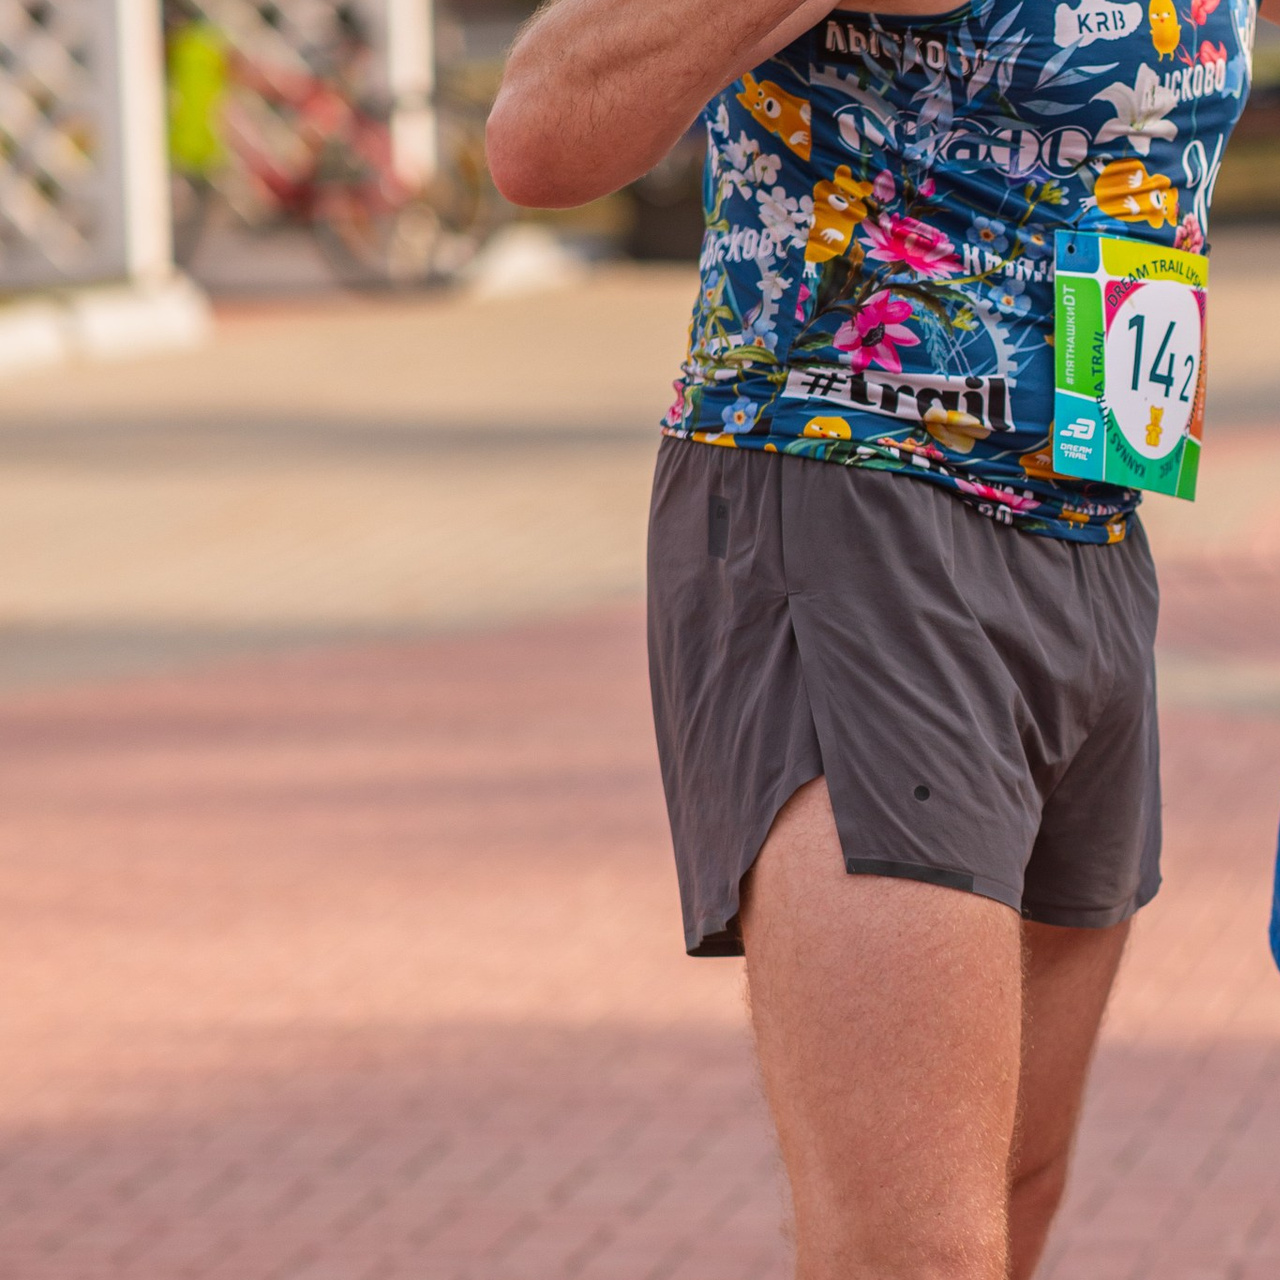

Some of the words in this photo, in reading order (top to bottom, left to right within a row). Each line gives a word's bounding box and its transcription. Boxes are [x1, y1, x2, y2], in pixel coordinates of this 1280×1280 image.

[1077, 9, 1126, 35] KRB
[1107, 263, 1150, 308] DREAM
[1151, 258, 1184, 276] TRAIL
[1090, 329, 1106, 378] TRAIL
[1059, 442, 1093, 456] DREAM
[1063, 450, 1089, 462] TRAIL
